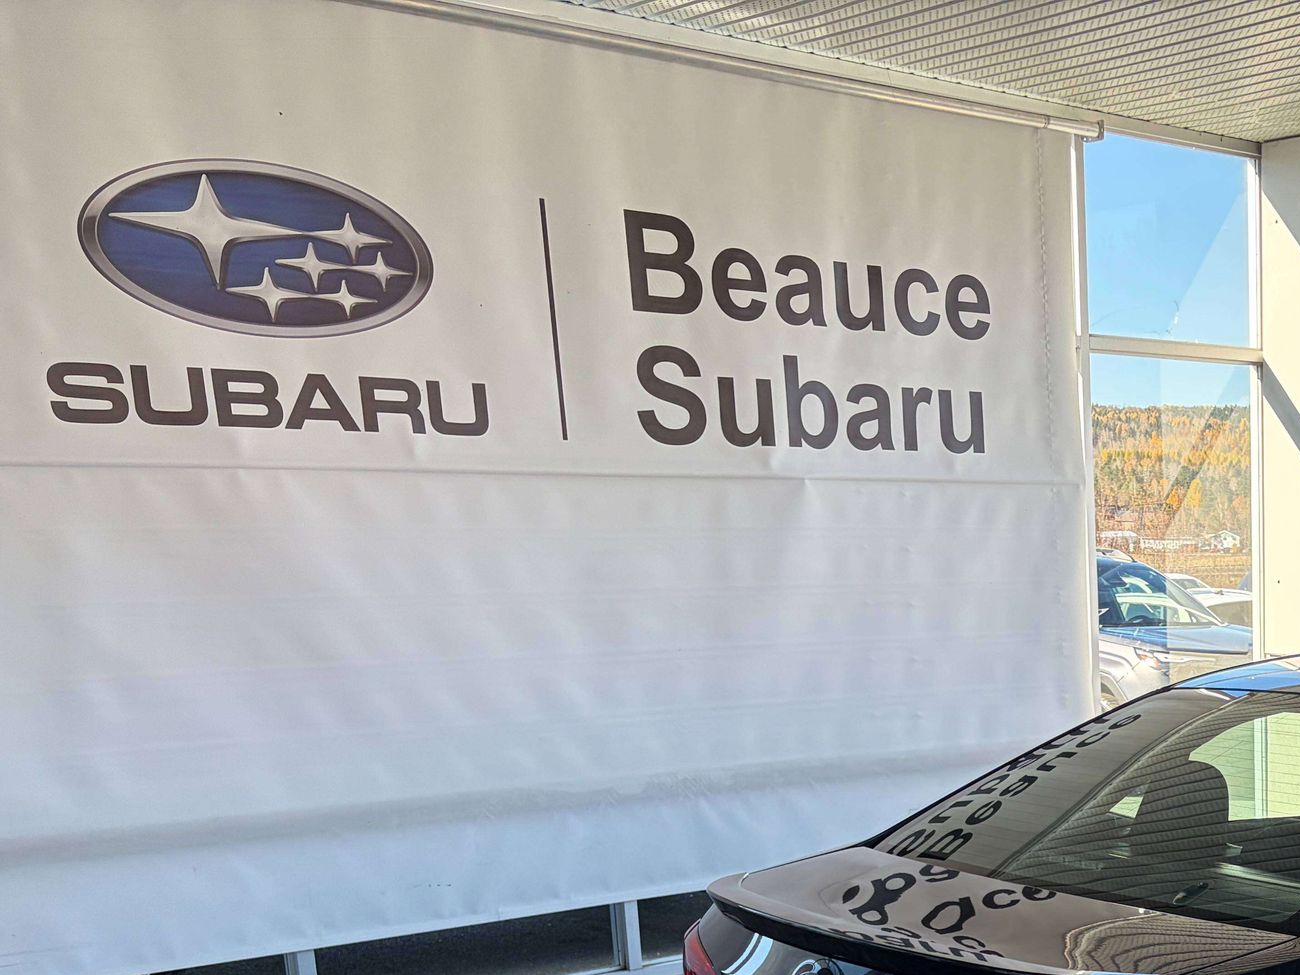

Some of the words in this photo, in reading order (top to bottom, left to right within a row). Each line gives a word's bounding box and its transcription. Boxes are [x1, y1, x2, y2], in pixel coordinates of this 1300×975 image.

[623, 208, 991, 341] Beauce
[46, 361, 489, 437] SUBARU
[636, 345, 985, 454] Subaru
